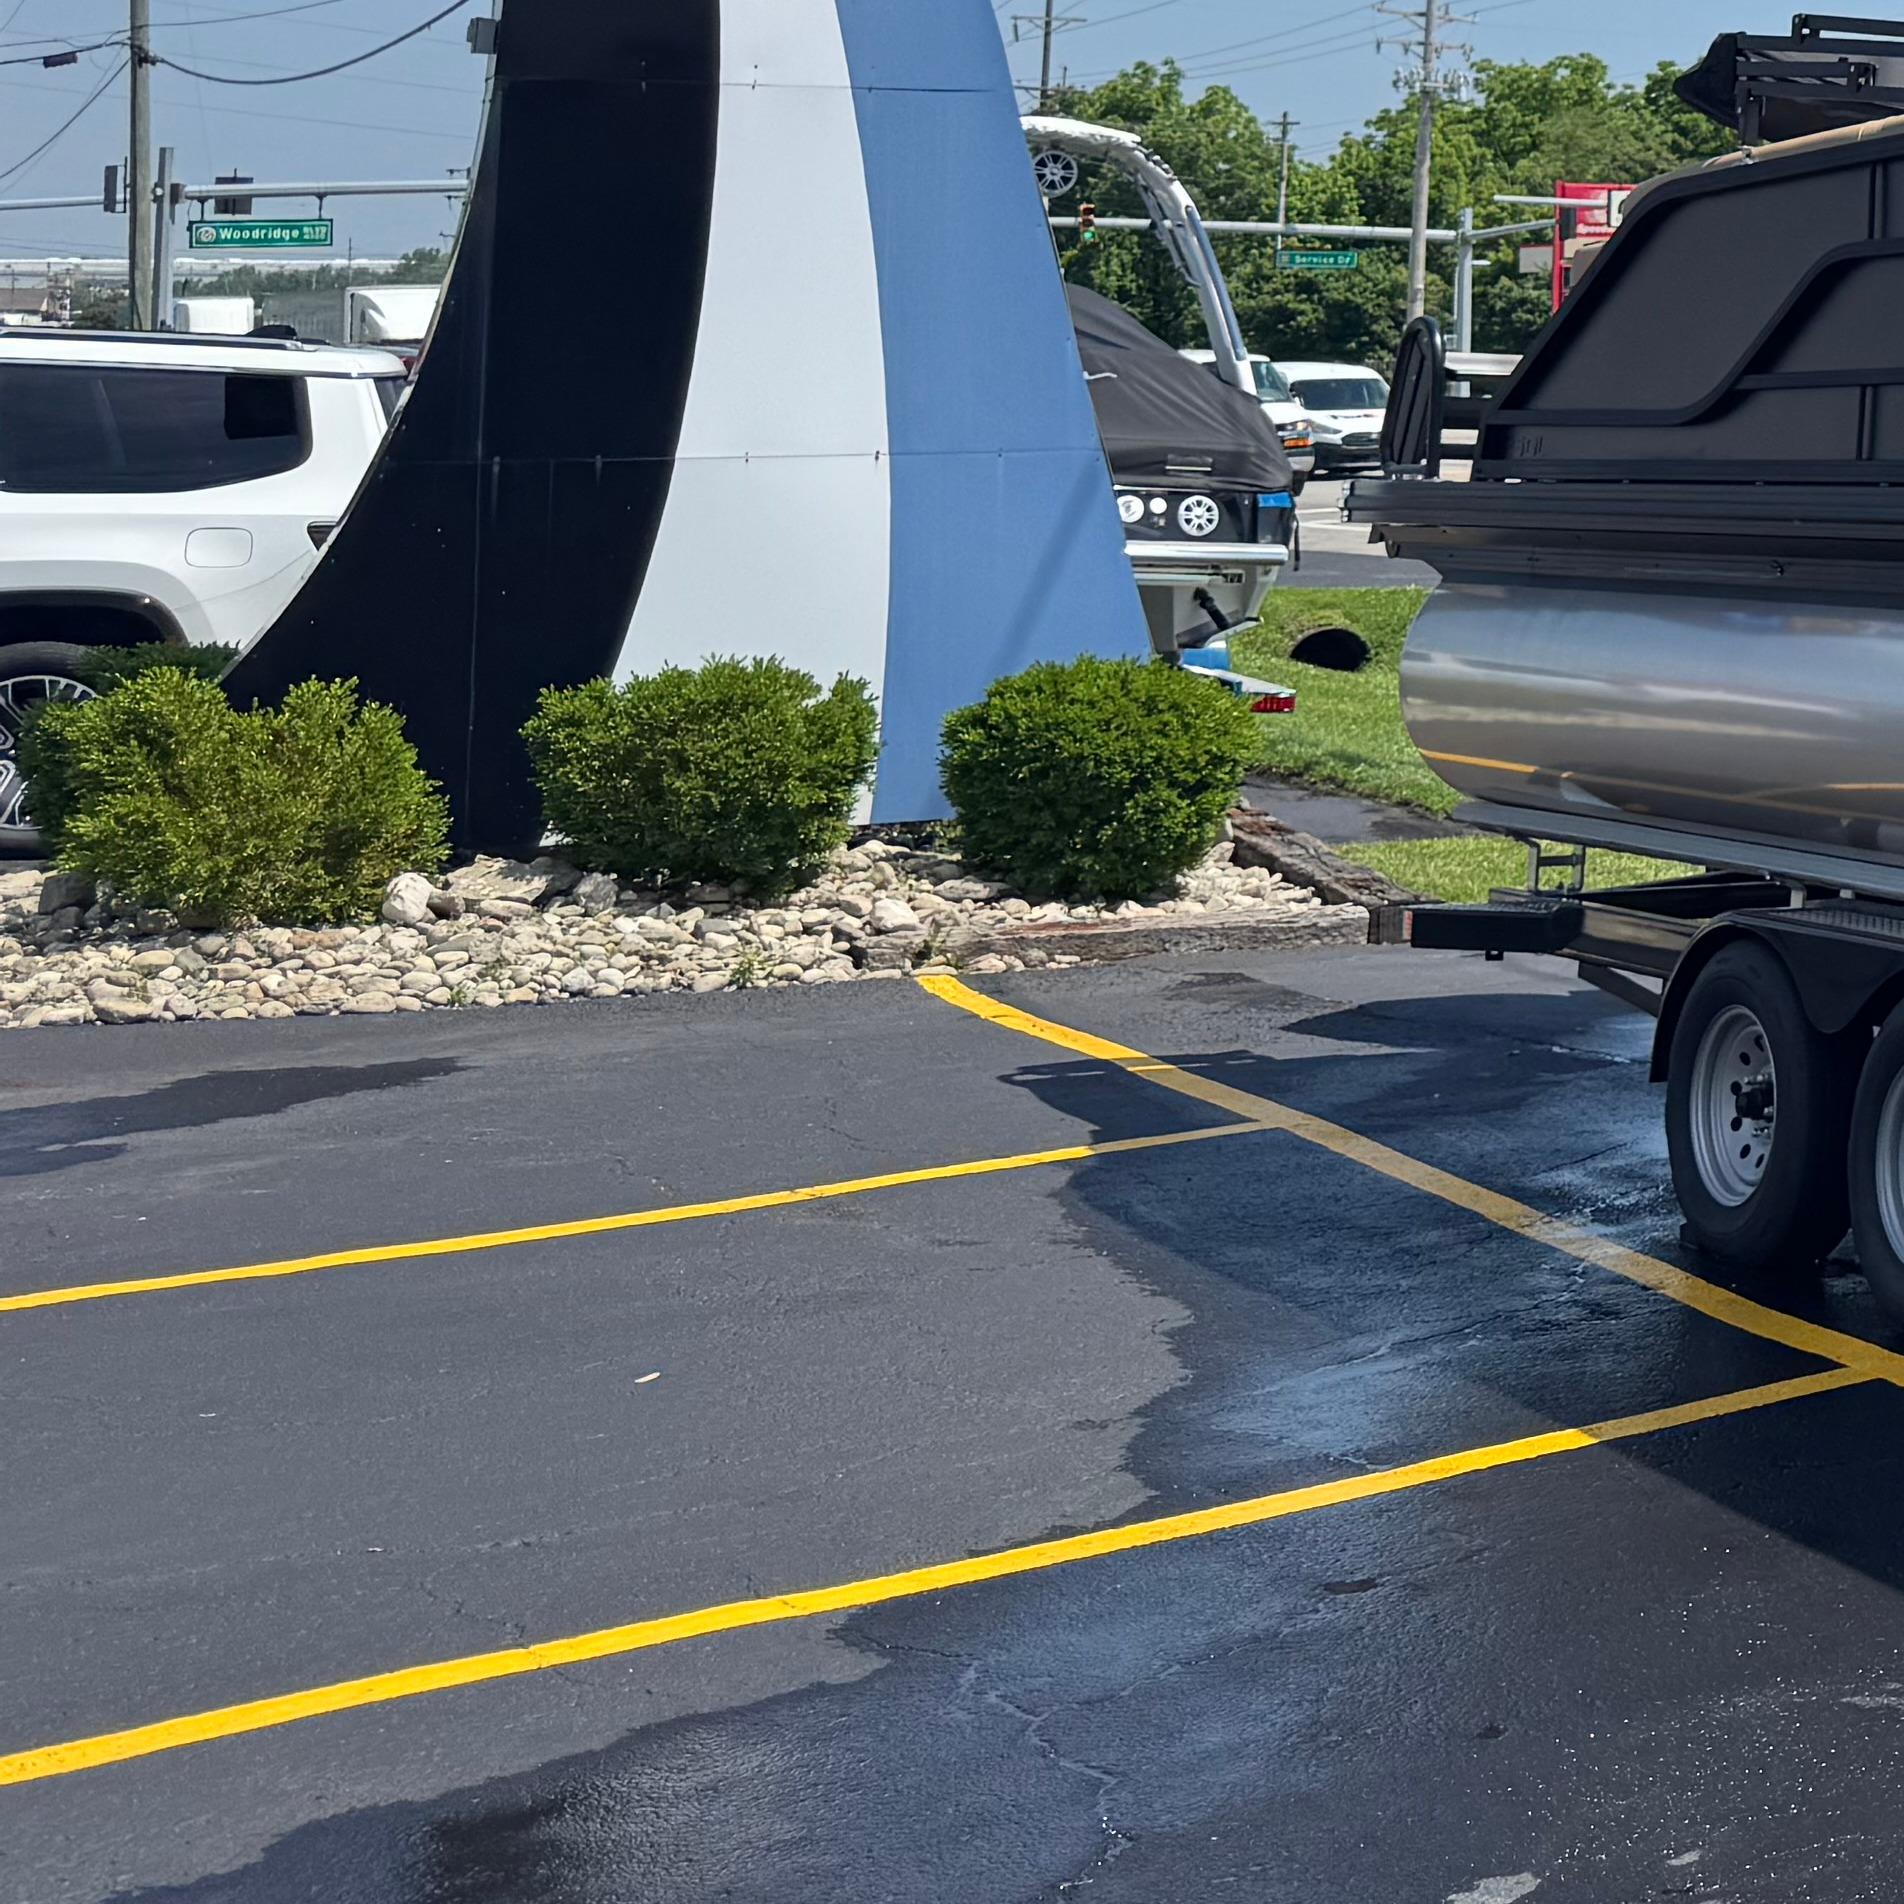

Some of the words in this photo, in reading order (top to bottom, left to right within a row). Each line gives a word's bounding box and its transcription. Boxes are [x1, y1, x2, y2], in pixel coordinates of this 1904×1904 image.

[219, 227, 299, 241] Woodridge
[1294, 255, 1335, 265] Service
[1337, 255, 1351, 264] Dr
